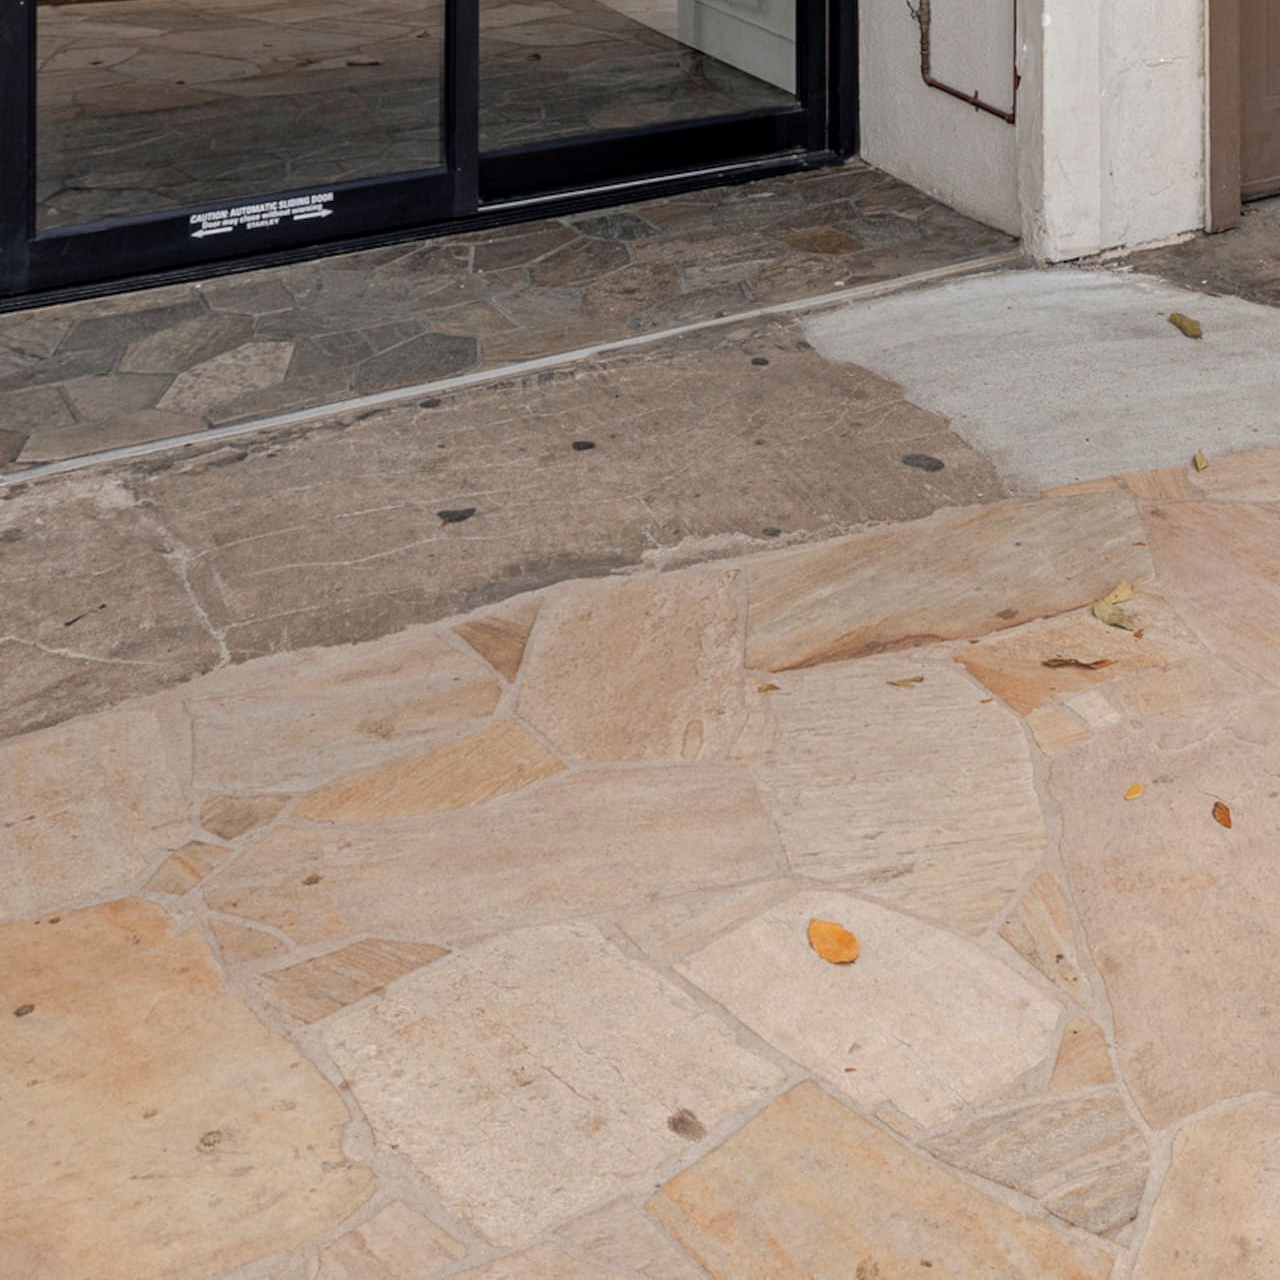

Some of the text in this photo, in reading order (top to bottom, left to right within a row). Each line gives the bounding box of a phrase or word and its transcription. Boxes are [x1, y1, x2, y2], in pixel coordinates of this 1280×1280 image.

[230, 201, 278, 218] AUTOMATIC
[278, 197, 310, 210] SLIDING
[311, 192, 334, 204] DOOR
[201, 220, 221, 230] Door
[221, 218, 238, 228] may
[262, 209, 290, 221] without
